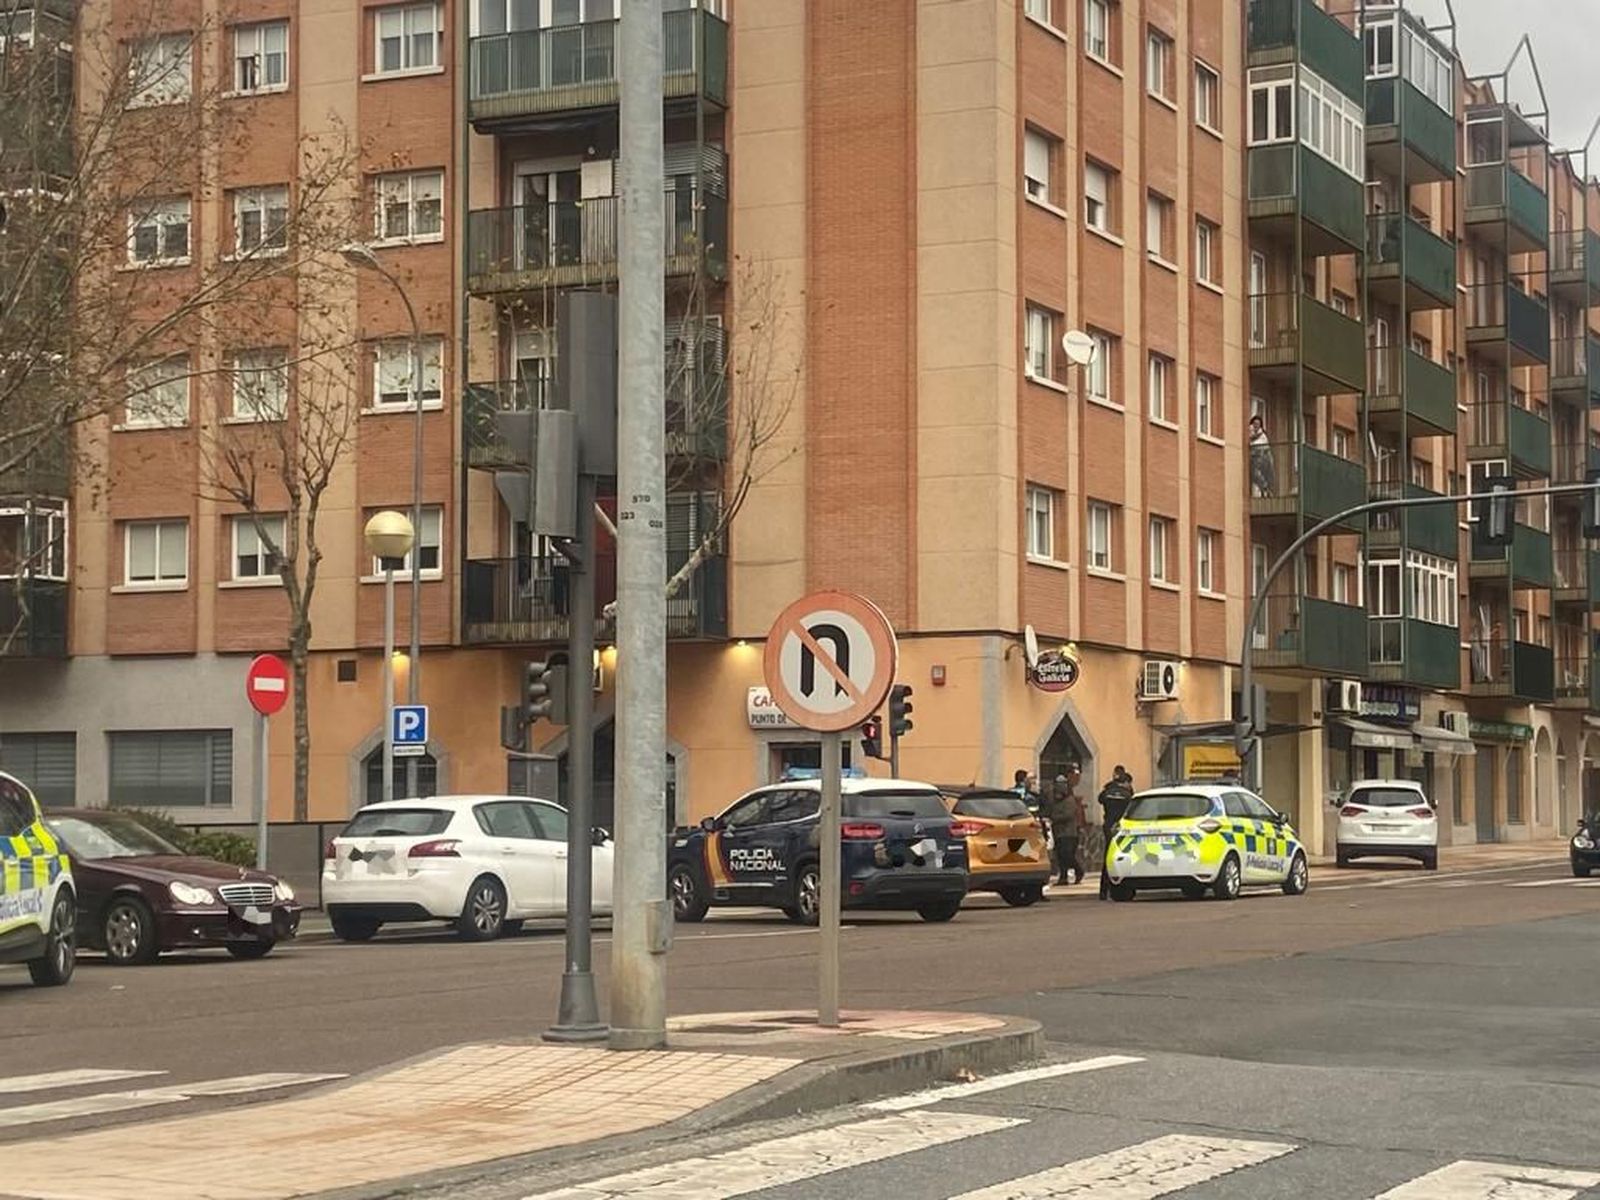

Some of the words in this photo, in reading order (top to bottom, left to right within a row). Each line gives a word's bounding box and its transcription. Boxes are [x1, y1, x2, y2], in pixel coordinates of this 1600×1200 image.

[751, 713, 776, 724] PUNTO
[399, 710, 420, 740] P
[730, 860, 787, 871] NACIONAL
